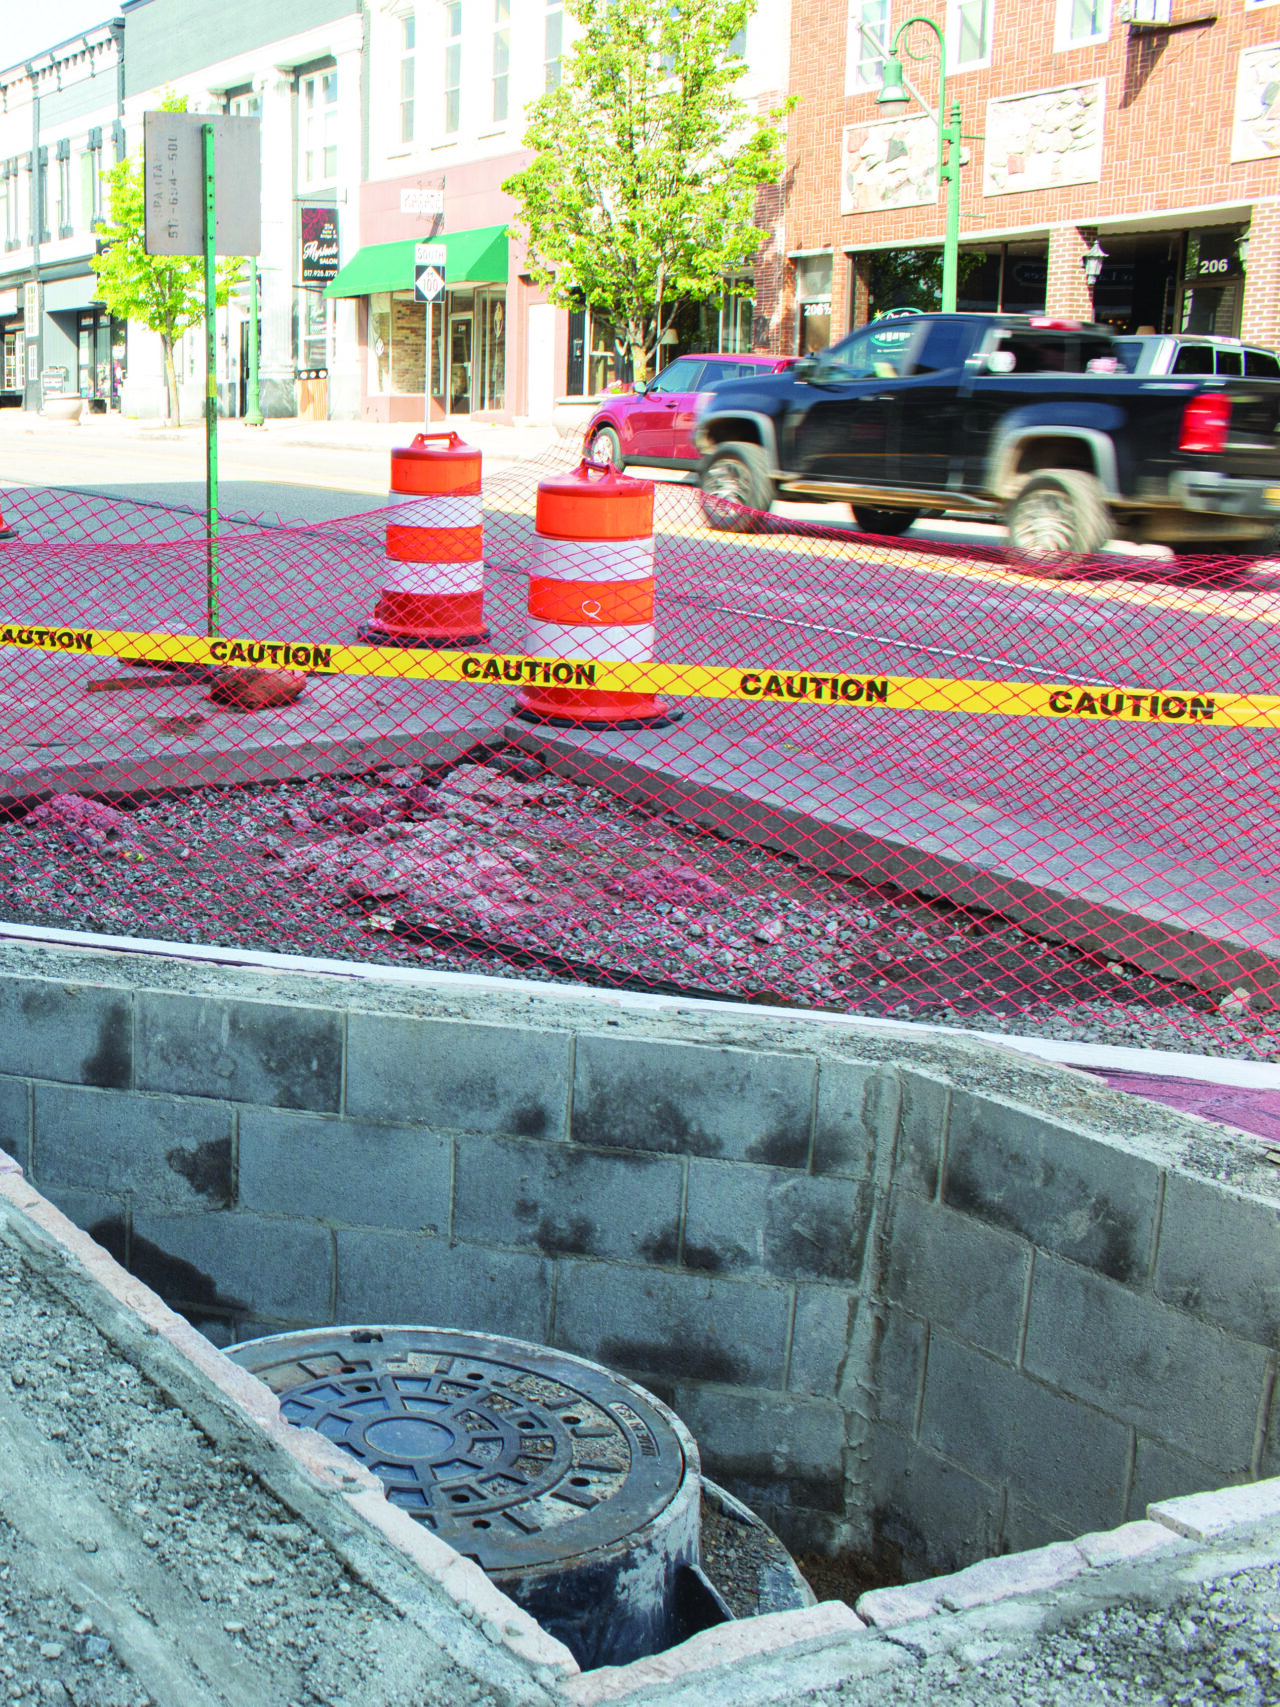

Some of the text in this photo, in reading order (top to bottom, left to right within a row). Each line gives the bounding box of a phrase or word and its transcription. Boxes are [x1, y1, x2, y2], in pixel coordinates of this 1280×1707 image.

[417, 247, 444, 260] SOUTH
[1199, 258, 1228, 274] 206
[422, 279, 439, 292] 100
[210, 641, 332, 668] CAUTION
[461, 657, 596, 686] CAUTION
[740, 673, 889, 703] CAUTION
[1048, 690, 1216, 721] CAUTION
